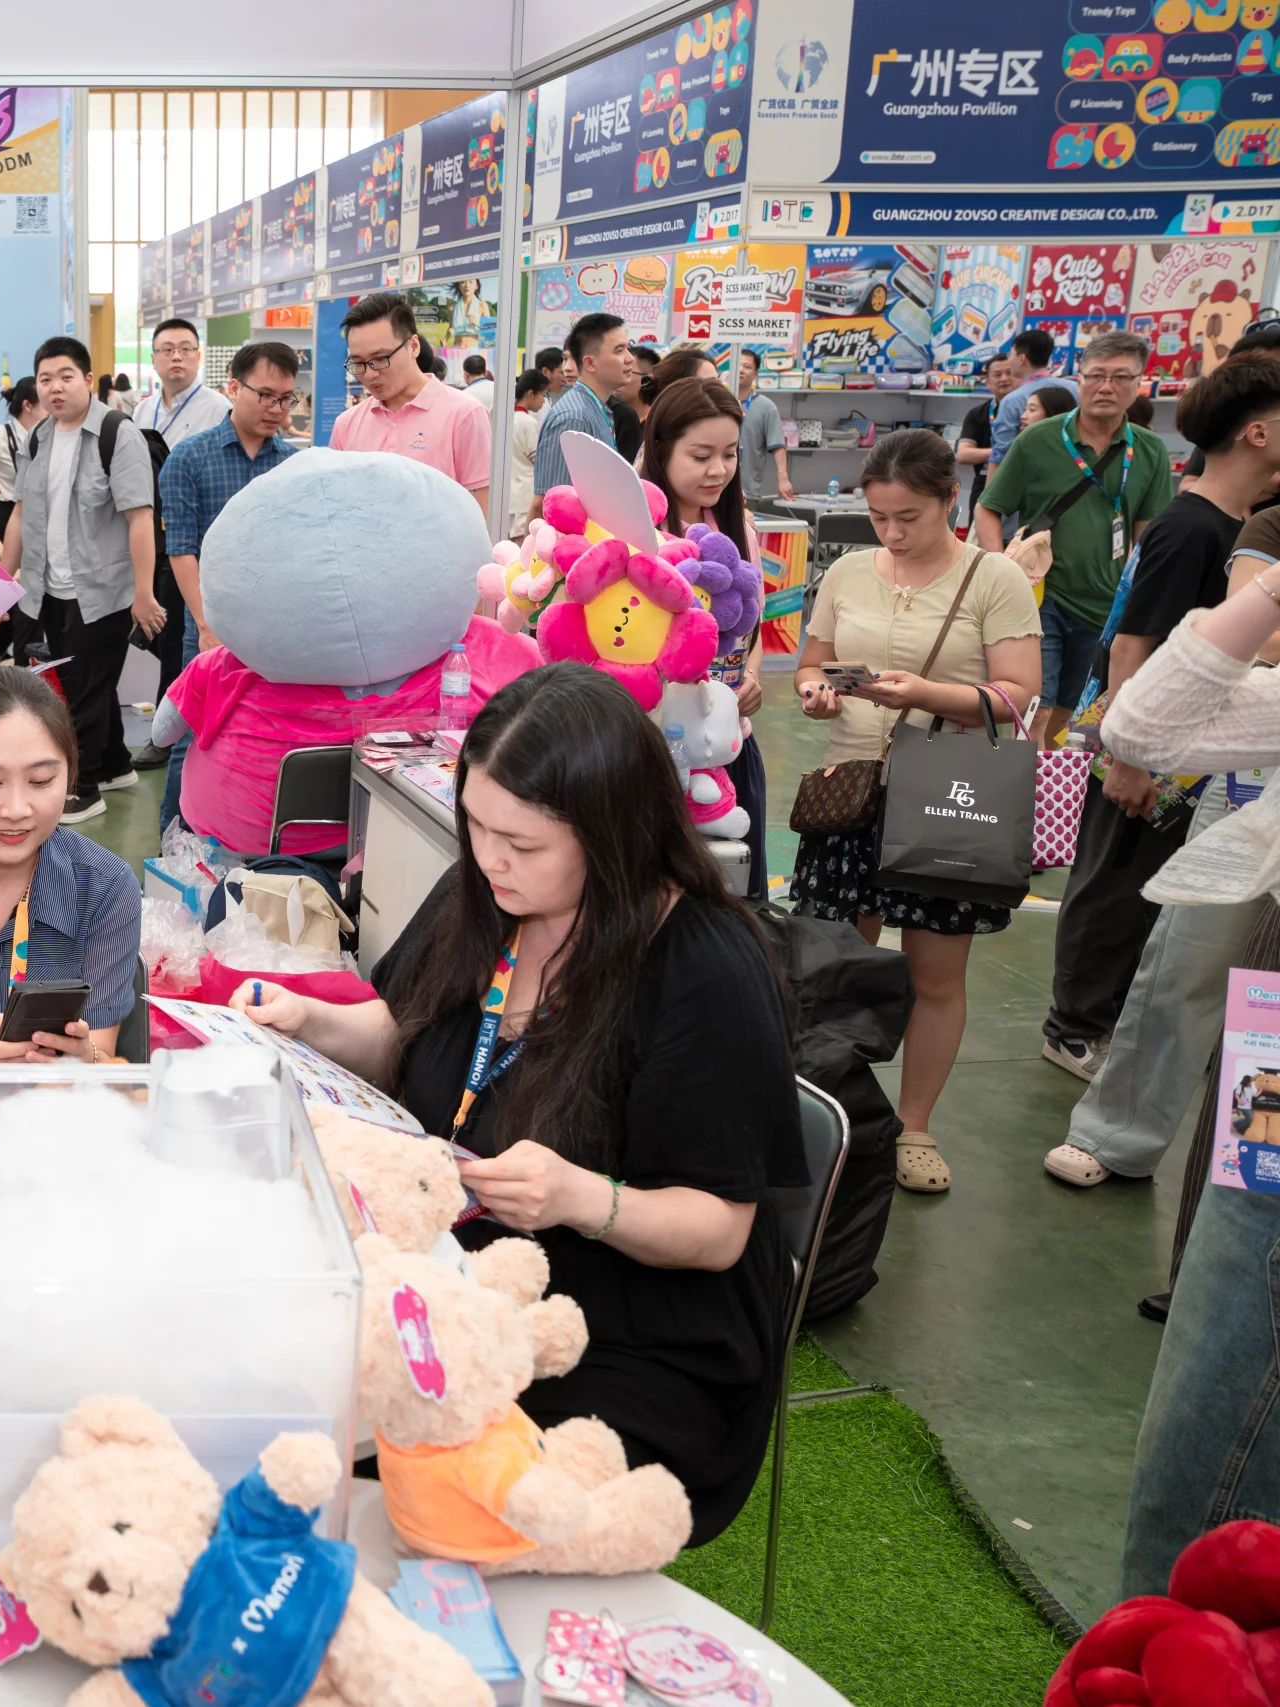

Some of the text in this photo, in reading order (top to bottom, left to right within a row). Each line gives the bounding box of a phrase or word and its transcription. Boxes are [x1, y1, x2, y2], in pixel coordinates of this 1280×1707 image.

[1082, 6, 1136, 18] Trendy Toys
[1167, 53, 1232, 65] Baby Products
[865, 47, 1043, 97] 广州专区
[1070, 98, 1123, 109] IP Licensing
[1251, 92, 1273, 102] Toys
[883, 102, 1017, 119] Guangzhou Pavilion
[569, 95, 632, 150] 广州专区
[574, 141, 623, 163] Guangzhou Pavilion
[1152, 141, 1198, 152] Stationery
[871, 152, 933, 162] www.ibte.com.vn
[423, 153, 464, 195] 广州专区
[720, 209, 739, 223] 2.D17
[762, 200, 815, 223] IBTE
[872, 208, 1159, 222] GUANGZHOU ZOVSO CREATIVE DESIGN CO.,LTD.
[1236, 204, 1273, 217] 2.D17
[574, 229, 603, 246] GUANGZHOU
[602, 226, 619, 241] ZOVSO
[619, 223, 643, 239] CREATIVE
[643, 221, 662, 235] DESIGN
[1053, 253, 1104, 283] Cute
[1140, 242, 1196, 305] HAPPY
[1164, 252, 1232, 299] PENCIL CASE
[726, 282, 764, 293] SCSS MARKET
[973, 264, 1012, 293] CIRCUS
[604, 290, 665, 309] Yummy
[1054, 278, 1105, 307] Retro
[718, 318, 792, 329] SCSS MARKET
[812, 329, 870, 353] Flying
[842, 343, 879, 361] Life
[924, 806, 999, 824] ELLEN TRANG
[470, 1017, 497, 1086] IBTE HANOI
